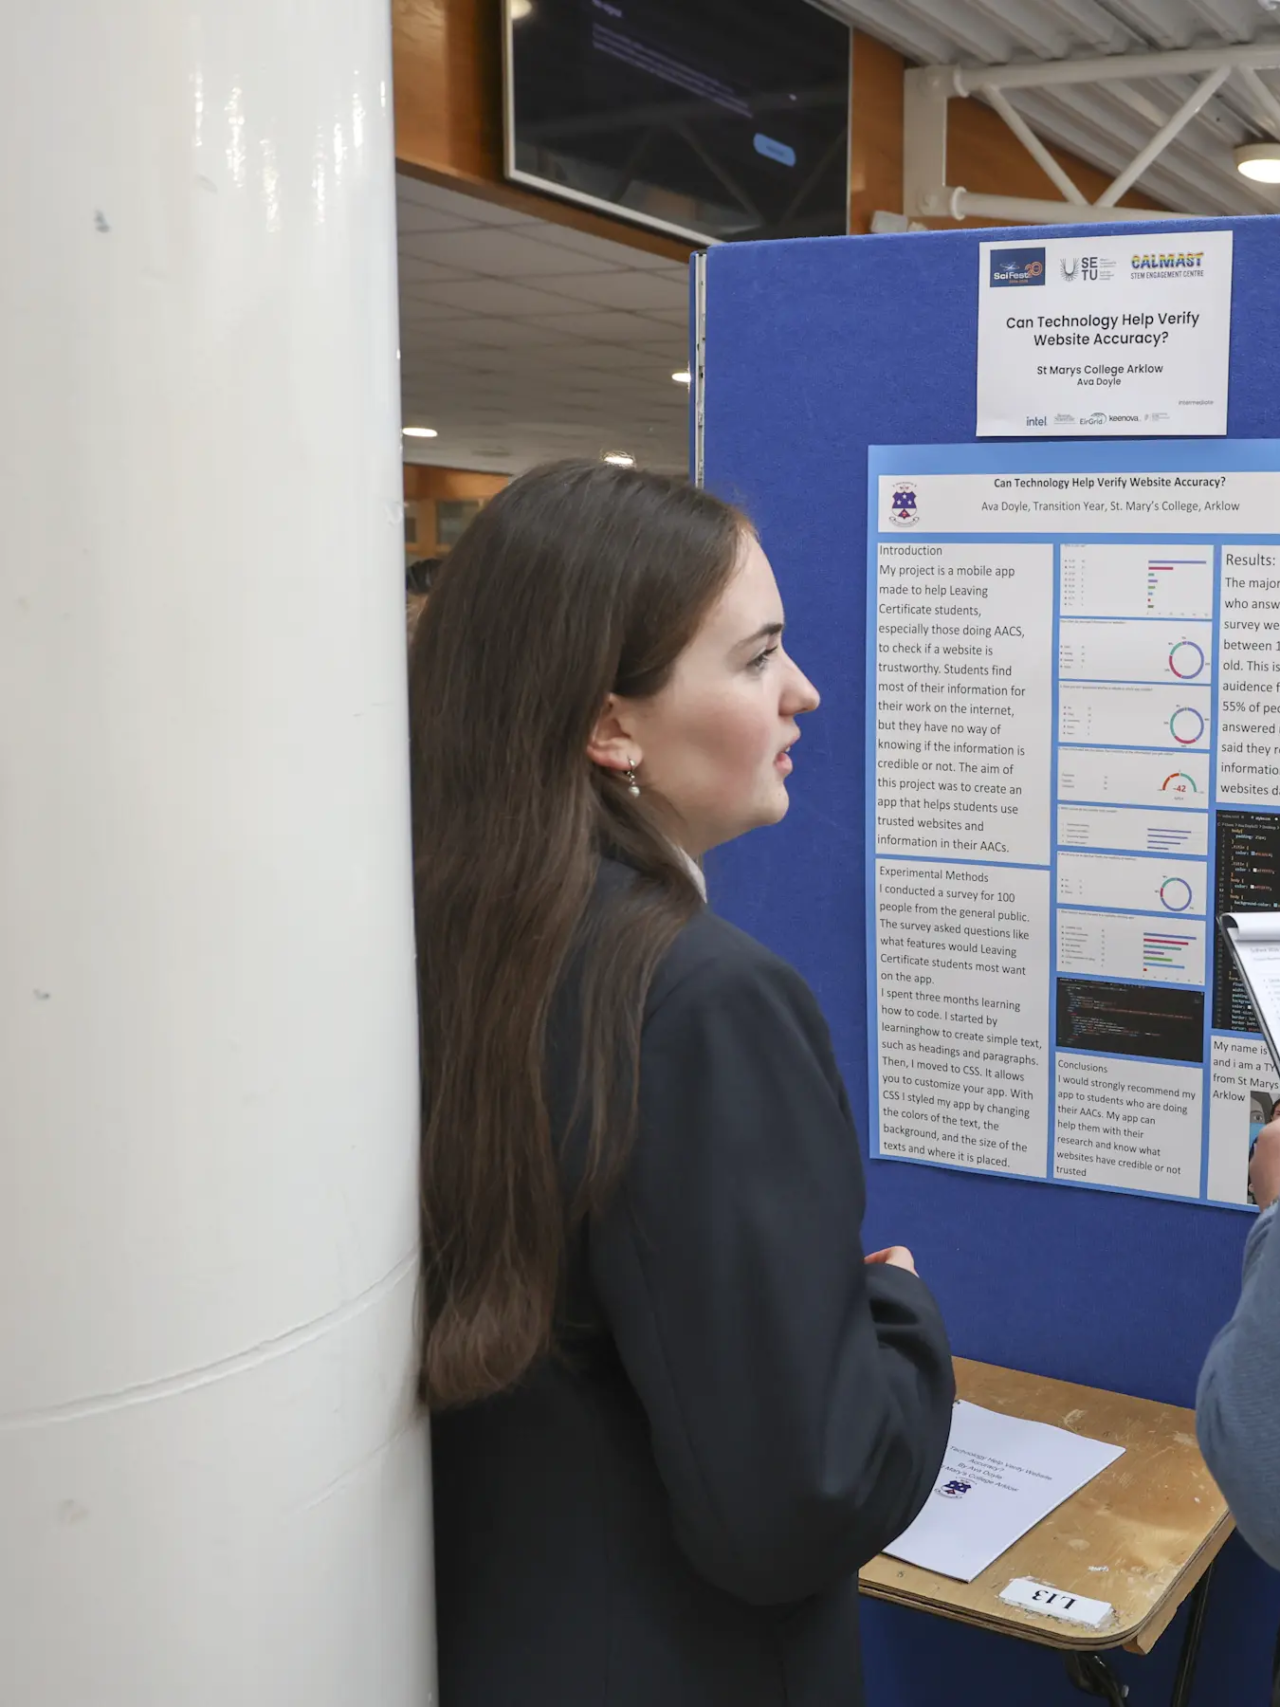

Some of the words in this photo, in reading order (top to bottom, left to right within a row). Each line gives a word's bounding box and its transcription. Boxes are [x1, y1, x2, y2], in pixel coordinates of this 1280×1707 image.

[1082, 257, 1098, 269] SE
[1131, 252, 1204, 269] CALMAST
[993, 272, 1029, 280] SciFest
[1082, 269, 1098, 281] TU
[1146, 271, 1182, 279] ENGAGEMENT
[1184, 270, 1204, 278] CENTRE
[1006, 317, 1034, 329] Can
[1037, 314, 1119, 330] Technology
[1122, 312, 1154, 329] Help
[1157, 311, 1200, 327] Verify
[1033, 333, 1090, 346] Website
[1093, 331, 1169, 347] Accuracy?
[1037, 365, 1047, 375] St
[1049, 365, 1082, 377] Marys
[1083, 364, 1125, 376] College
[1126, 363, 1164, 373] Arklow
[1076, 378, 1094, 386] Ava
[1096, 377, 1121, 387] Doyle
[1026, 416, 1047, 427] intel
[1079, 418, 1103, 426] EirGrid
[993, 478, 1012, 488] Can
[1013, 477, 1070, 489] Technology
[1071, 477, 1095, 489] Help
[1096, 476, 1127, 489] Verify
[1129, 476, 1171, 487] Website
[1173, 476, 1226, 488] Accuracy?
[981, 501, 999, 511] Ava
[1001, 501, 1031, 513] Doyle,
[1032, 501, 1081, 511] Transition
[1083, 501, 1108, 512] Year,
[1110, 500, 1123, 511] St.
[1125, 500, 1159, 512] Mary’s
[1161, 500, 1201, 513] College,
[1203, 500, 1240, 511] Arklow
[879, 545, 943, 556] Introduction
[1226, 553, 1275, 566] Results:
[879, 564, 896, 577] My
[898, 565, 935, 577] project
[937, 565, 945, 576] is
[947, 567, 954, 576] a
[956, 565, 992, 576] mobile
[994, 568, 1015, 578] app
[1224, 576, 1246, 588] The
[879, 584, 909, 595] made
[911, 585, 922, 595] to
[924, 584, 947, 597] help
[949, 585, 988, 599] Leaving
[878, 603, 932, 615] Certificate
[934, 604, 981, 617] students,
[1224, 598, 1249, 609] who
[878, 623, 929, 636] especially
[931, 624, 960, 635] those
[962, 624, 992, 638] doing
[993, 625, 1025, 638] AACS,
[1224, 621, 1260, 632] survey
[879, 865, 943, 879] Experimental
[945, 870, 989, 882] Methods
[884, 885, 935, 896] conducted
[937, 889, 944, 897] a
[946, 890, 978, 901] survey
[980, 889, 995, 901] for
[997, 892, 1015, 903] 100
[879, 902, 912, 913] people
[914, 903, 938, 914] from
[940, 905, 957, 916] the
[958, 909, 995, 919] general
[997, 910, 1030, 922] public.
[1213, 1040, 1229, 1053] My
[1230, 1044, 1258, 1054] name
[1260, 1044, 1268, 1056] is
[1057, 1059, 1108, 1073] Conclusions
[1213, 1058, 1231, 1067] and
[1238, 1061, 1253, 1070] am
[1255, 1063, 1261, 1071] a
[1263, 1062, 1275, 1072] TY
[1062, 1076, 1089, 1086] would
[1090, 1079, 1125, 1092] strongly
[1127, 1084, 1180, 1097] recommend
[1181, 1091, 1196, 1100] my
[1213, 1073, 1235, 1084] from
[1237, 1076, 1247, 1085] St
[1249, 1077, 1279, 1090] Marys
[1212, 1089, 1246, 1101] Arklow
[1057, 1091, 1074, 1100] app
[1075, 1092, 1085, 1101] to
[1086, 1094, 1124, 1105] students
[1125, 1098, 1145, 1108] who
[1146, 1102, 1161, 1110] are
[1162, 1102, 1188, 1115] doing
[950, 1445, 987, 1460] Technology
[987, 1457, 1003, 1466] Help
[968, 1473, 994, 1485] College
[1032, 1589, 1077, 1610] L13
